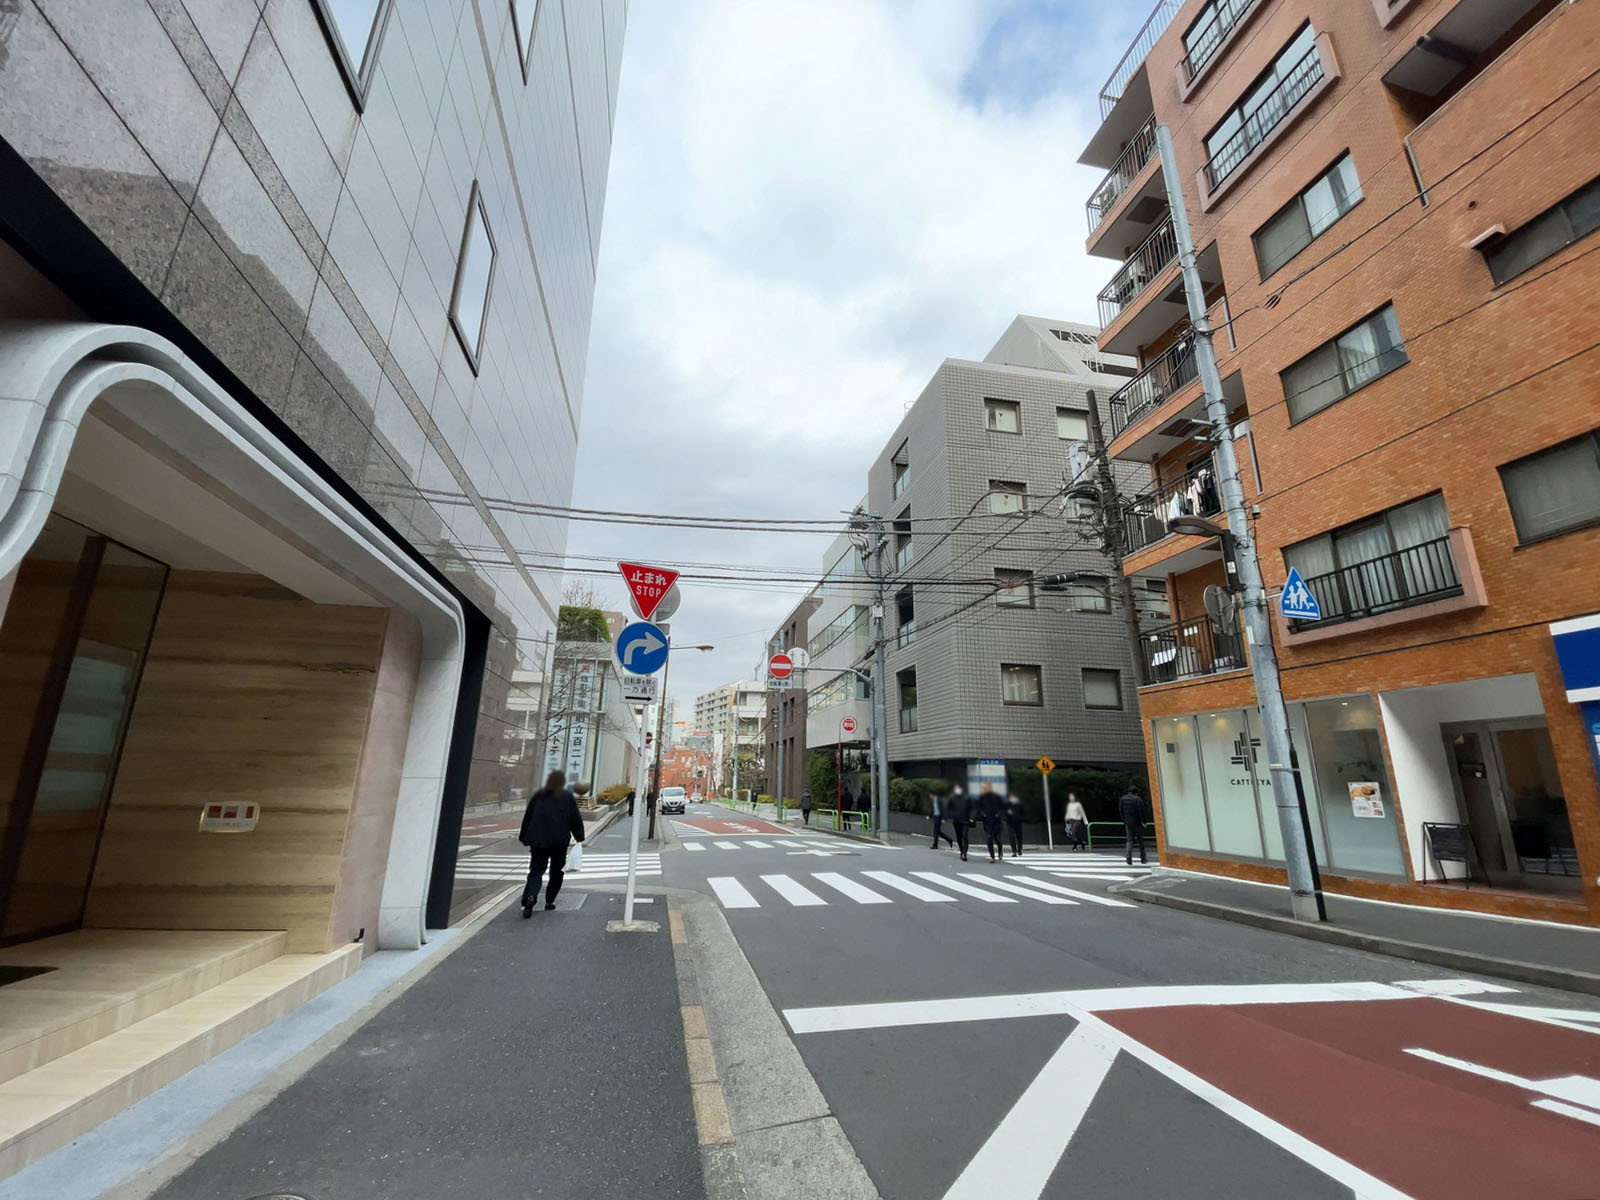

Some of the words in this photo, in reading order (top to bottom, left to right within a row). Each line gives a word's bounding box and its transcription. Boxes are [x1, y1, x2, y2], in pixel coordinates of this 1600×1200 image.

[630, 569, 667, 586] 止まれ
[636, 585, 662, 598] STOP
[623, 686, 656, 695] 一方通行
